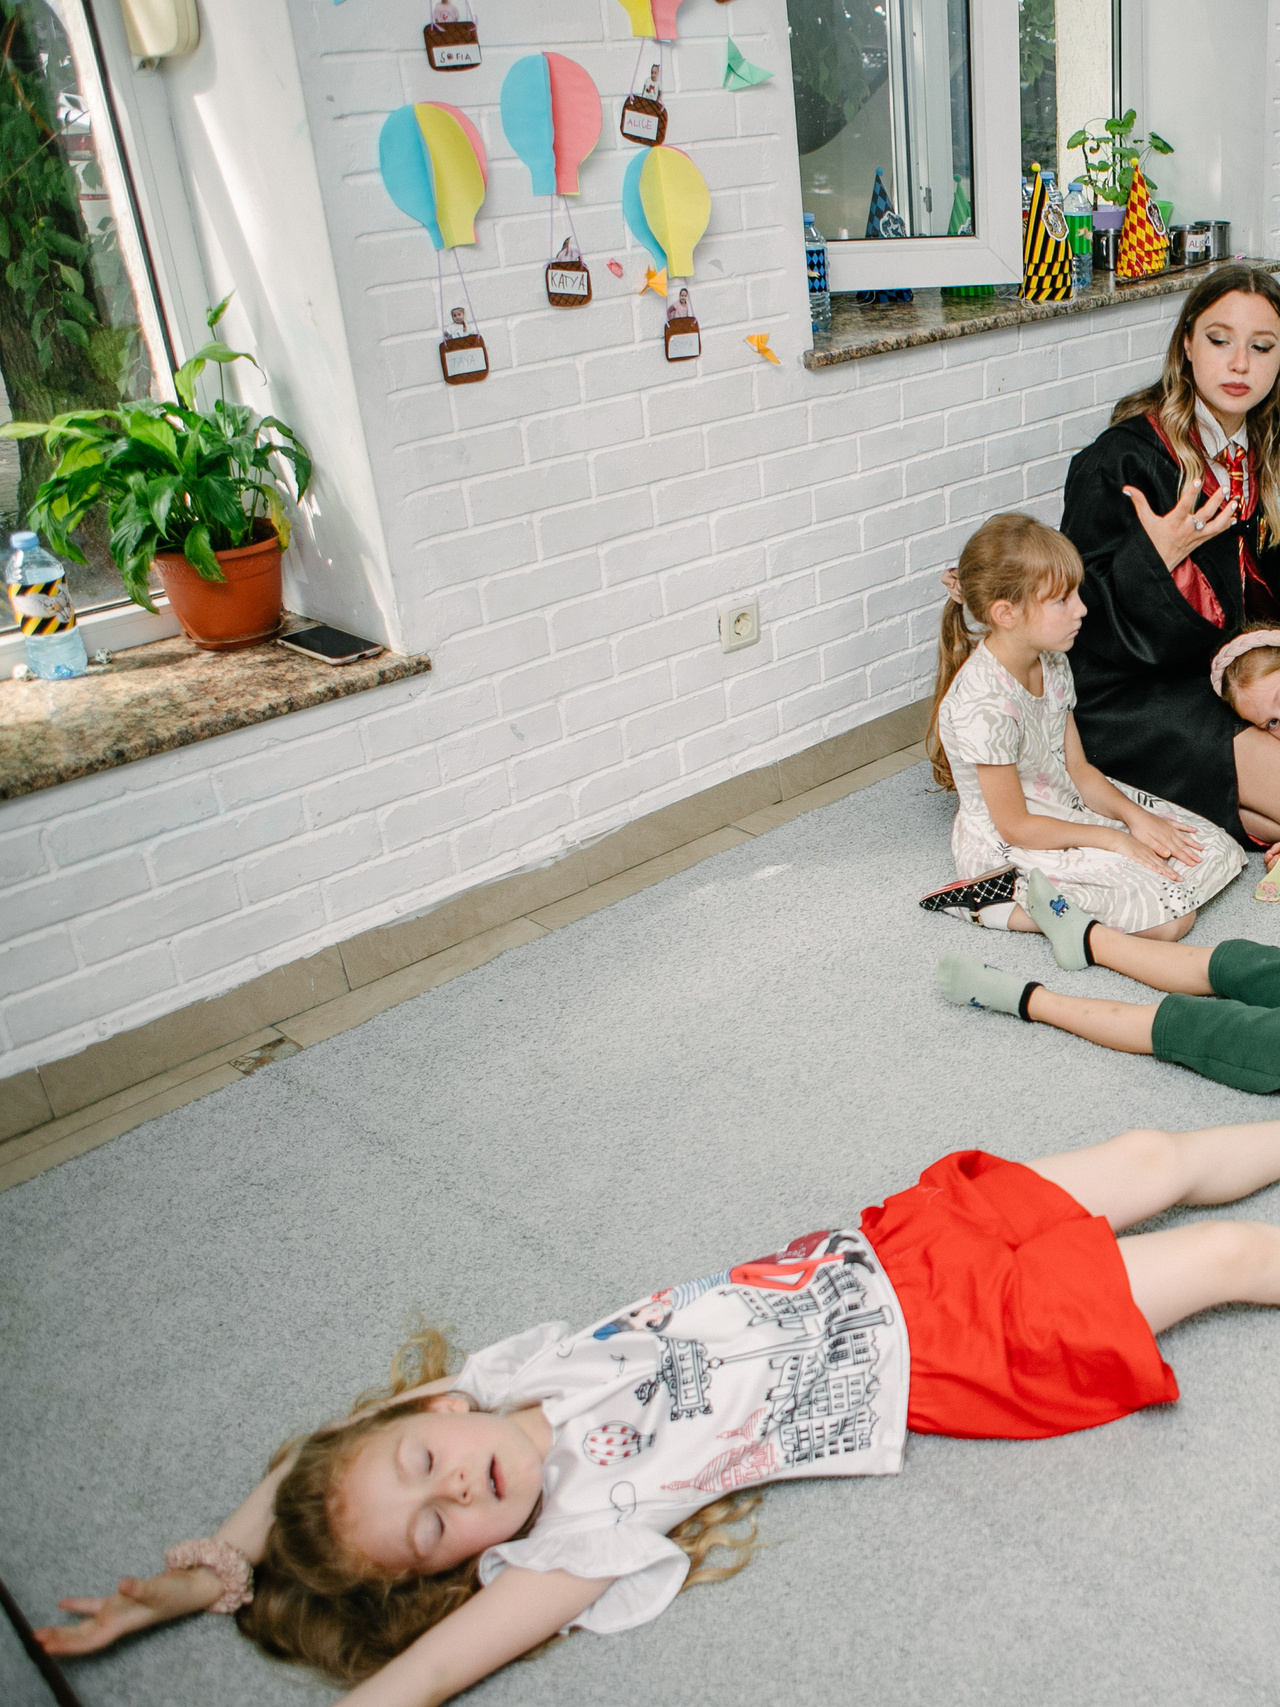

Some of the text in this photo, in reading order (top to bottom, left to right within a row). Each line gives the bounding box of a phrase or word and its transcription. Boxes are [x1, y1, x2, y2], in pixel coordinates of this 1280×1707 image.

[440, 51, 473, 63] SOFIA
[627, 119, 653, 130] ALICE
[550, 271, 586, 291] KATYA
